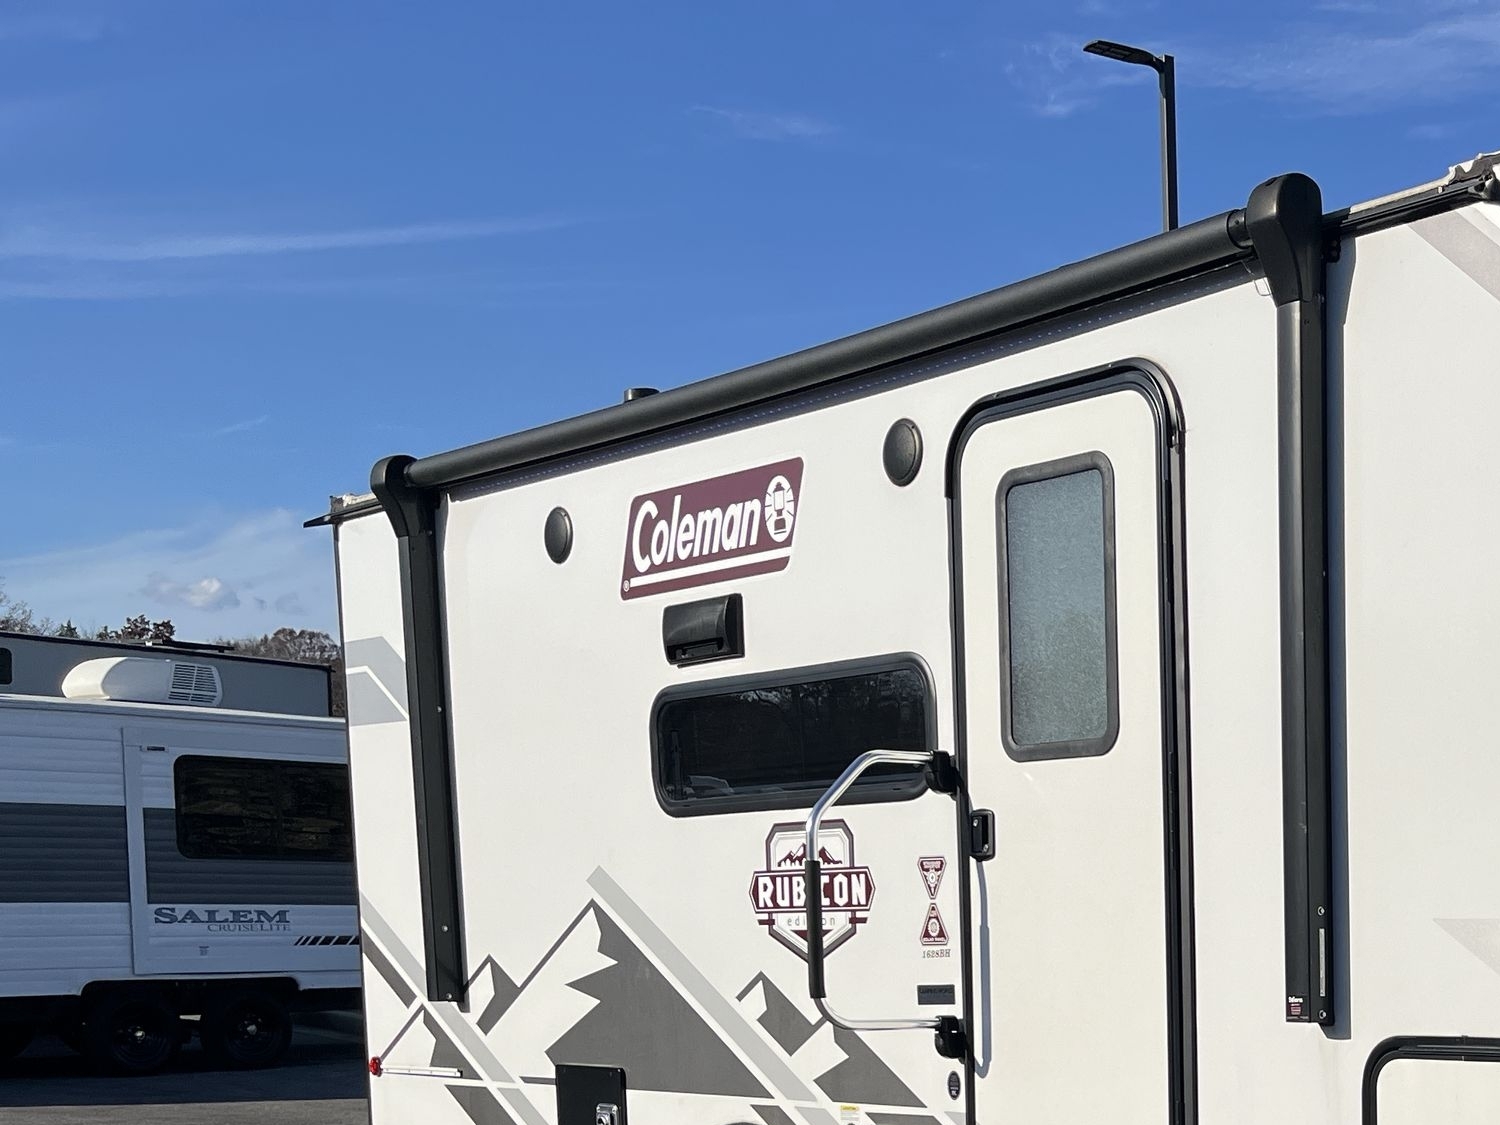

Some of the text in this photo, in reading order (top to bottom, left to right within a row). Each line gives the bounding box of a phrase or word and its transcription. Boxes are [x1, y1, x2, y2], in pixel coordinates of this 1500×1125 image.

[632, 495, 761, 573] Coleman
[757, 873, 867, 908] RUBCON
[154, 907, 290, 924] SALEM
[787, 917, 836, 927] edion
